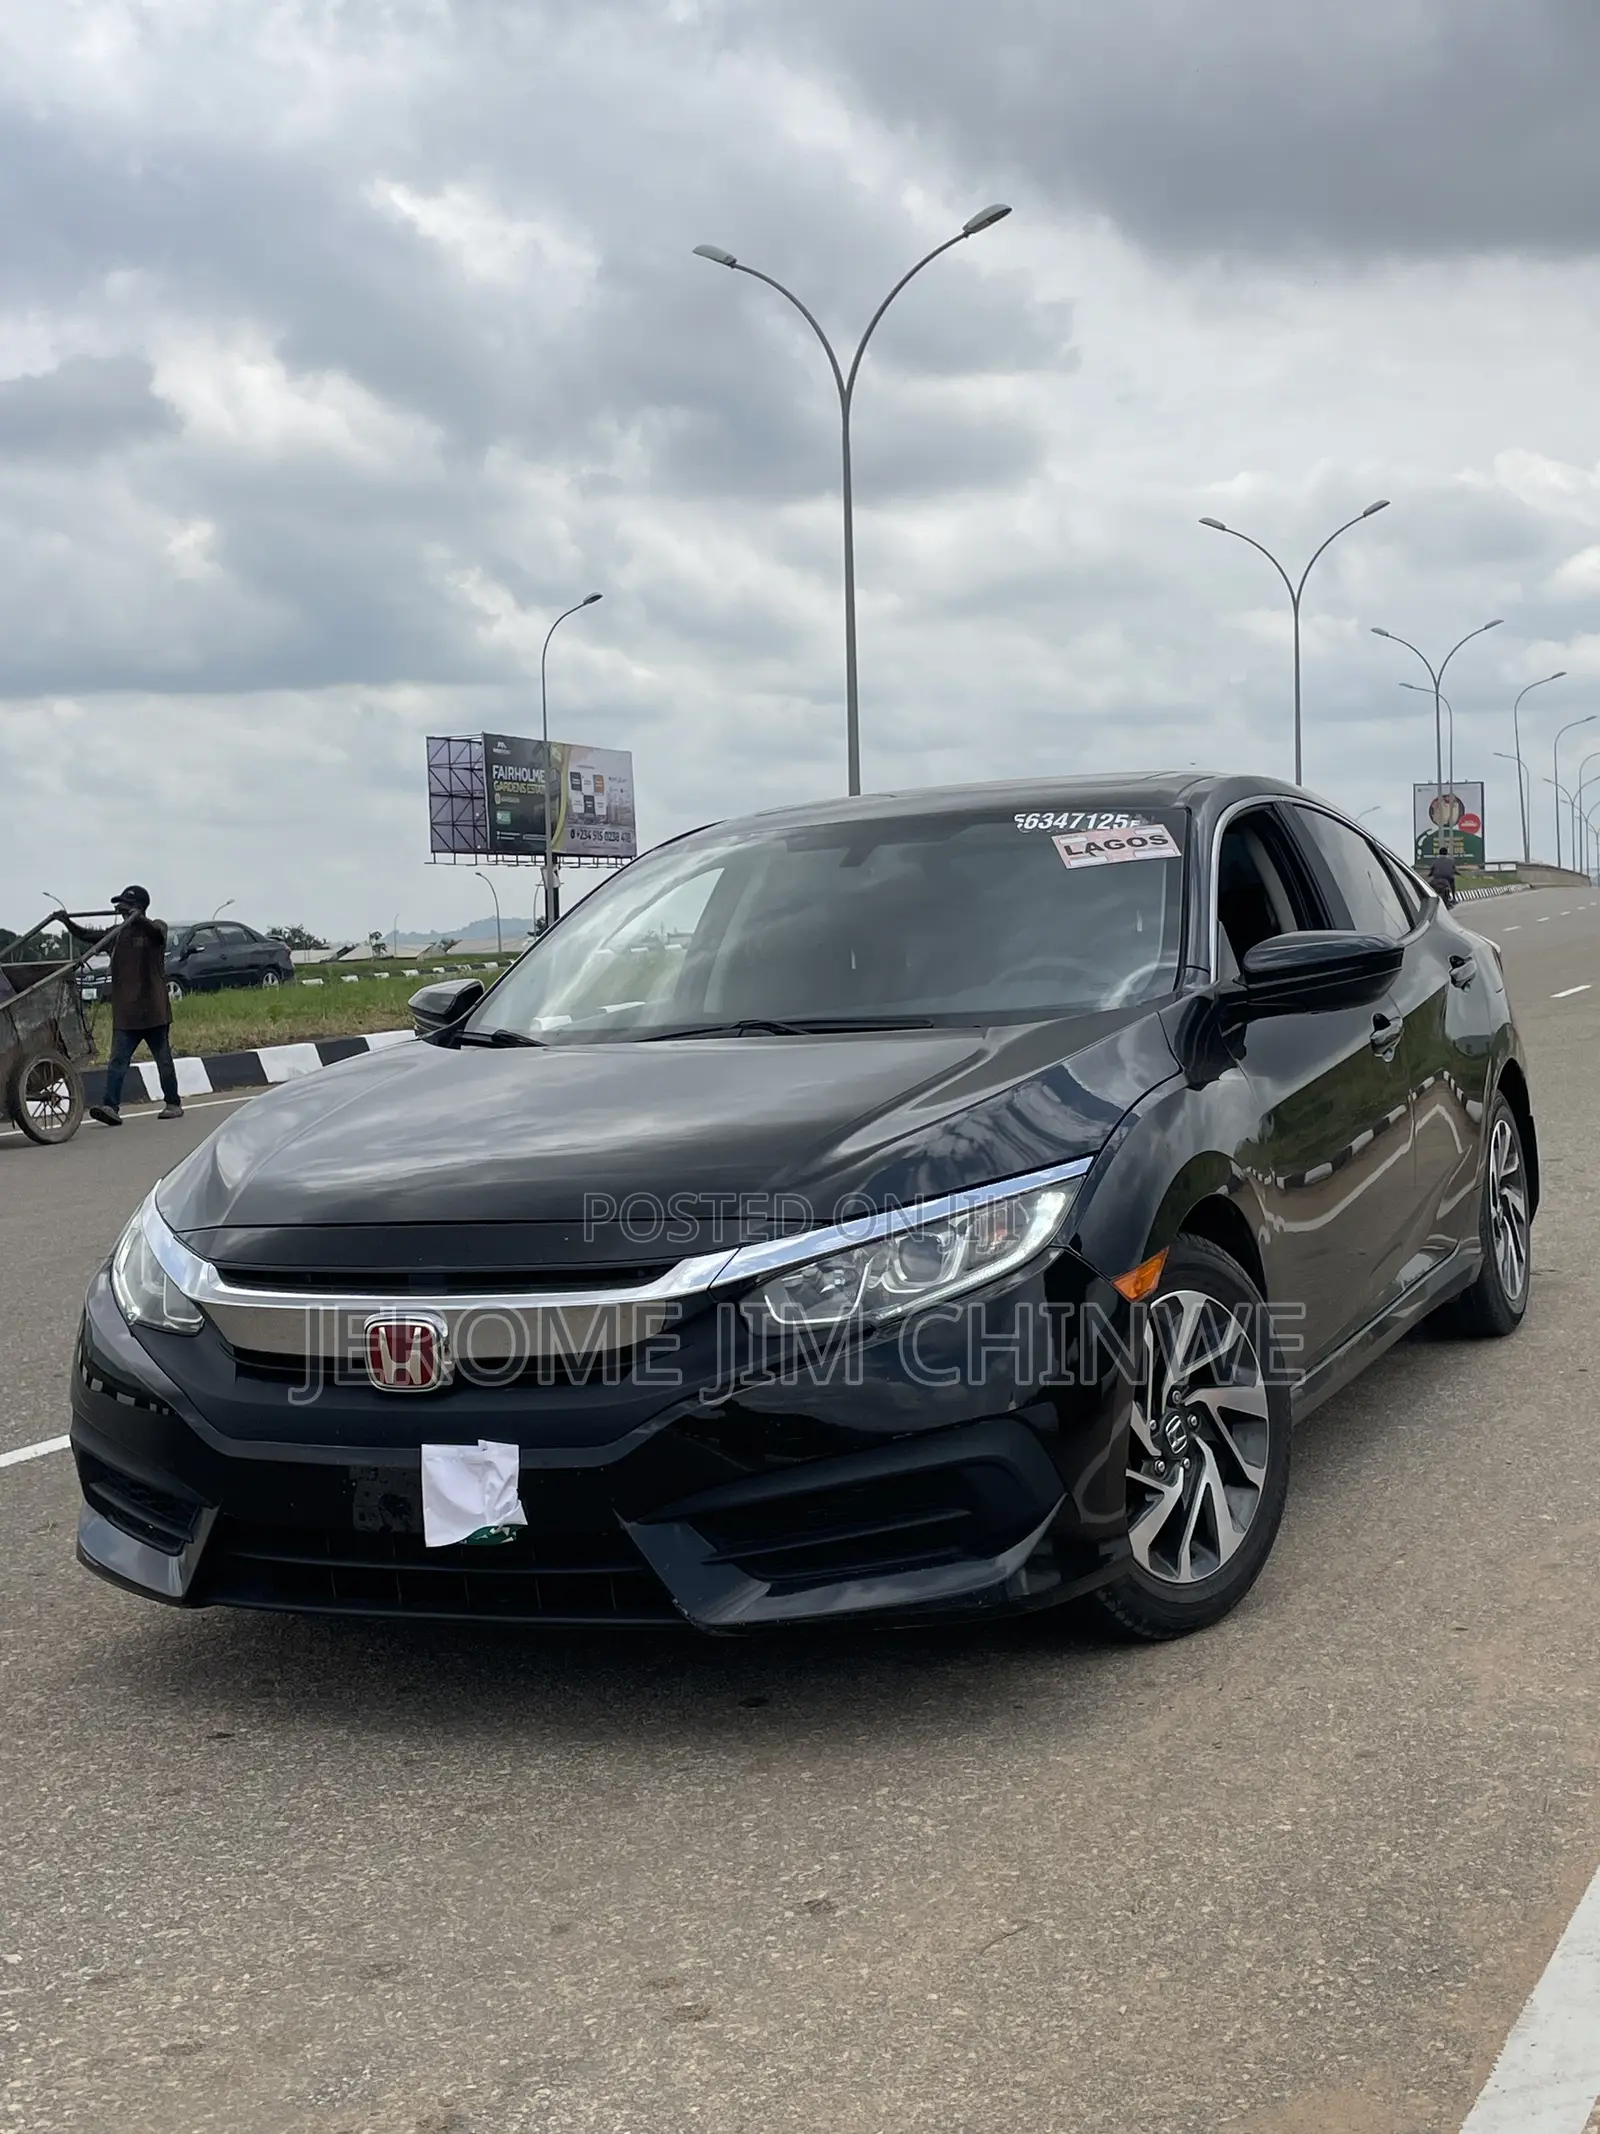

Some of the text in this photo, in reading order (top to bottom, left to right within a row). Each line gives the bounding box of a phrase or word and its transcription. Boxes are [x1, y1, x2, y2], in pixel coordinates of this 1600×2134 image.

[492, 764, 546, 784] FAIRHOLME
[493, 780, 546, 795] GARDENS ESTAT
[1063, 834, 1169, 857] LAGOS
